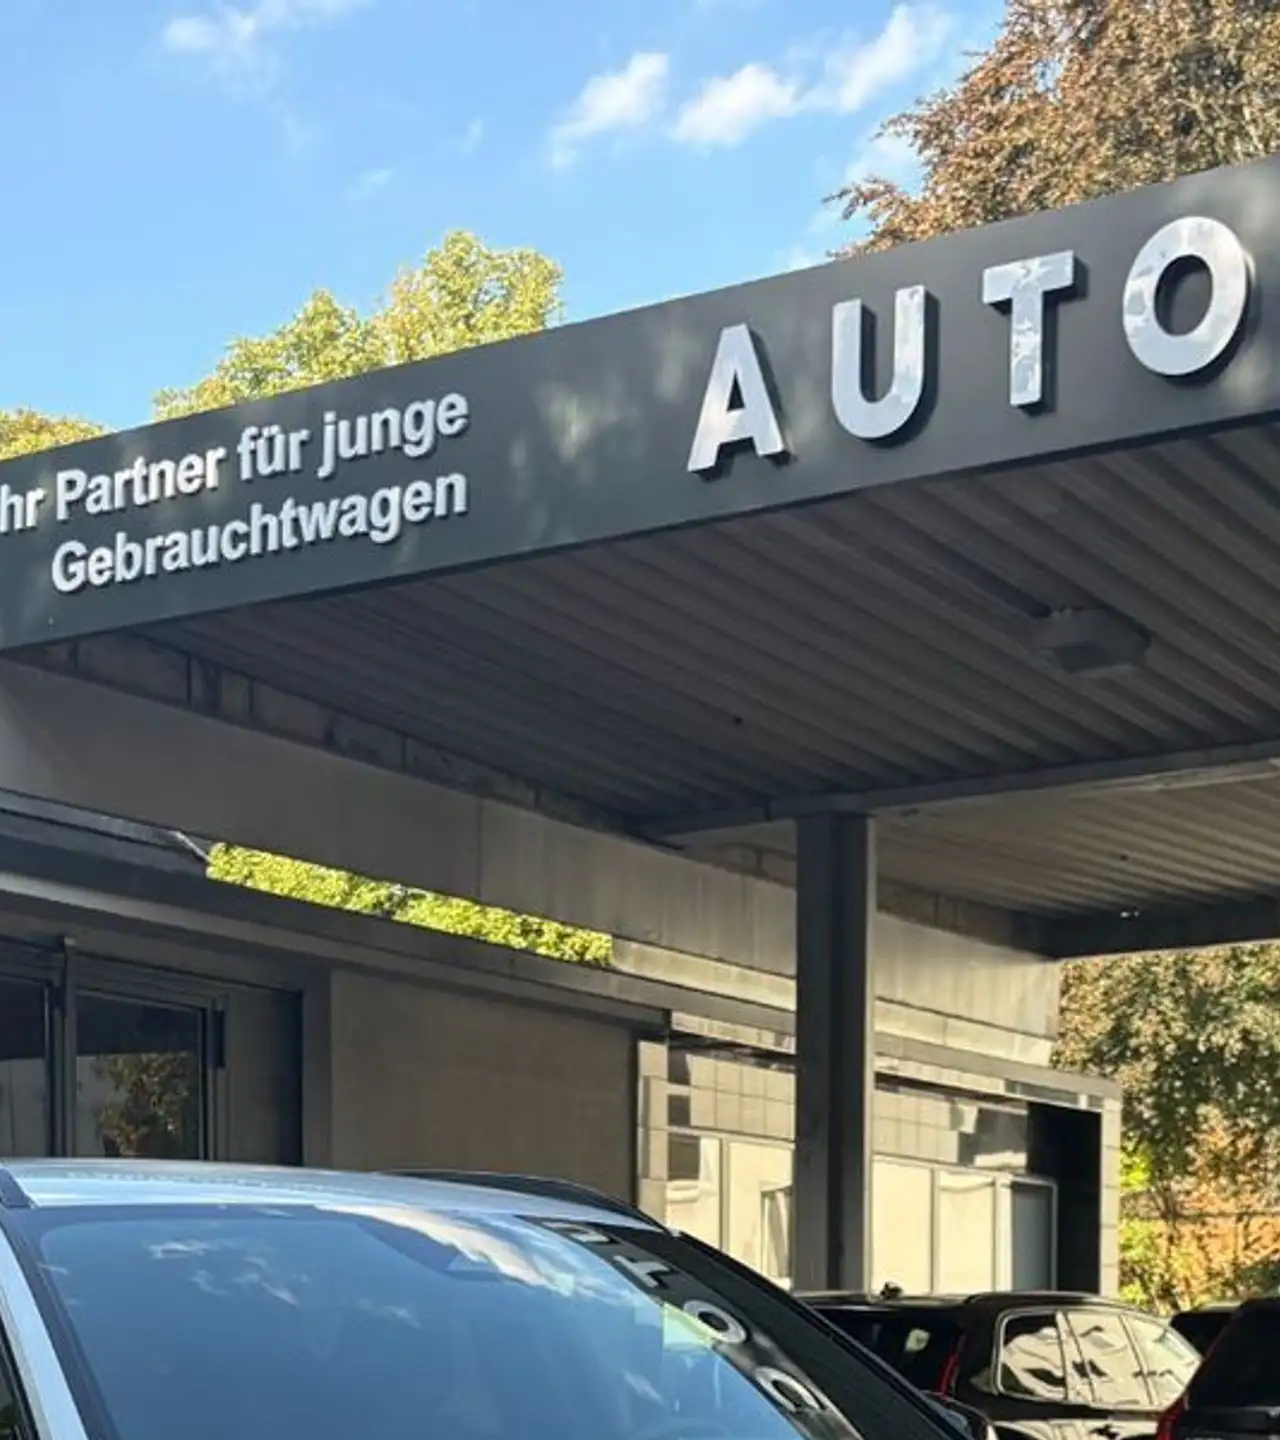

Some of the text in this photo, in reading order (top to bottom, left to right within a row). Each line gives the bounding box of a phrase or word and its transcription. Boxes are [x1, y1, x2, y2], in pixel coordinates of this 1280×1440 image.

[56, 445, 226, 521] Partner
[238, 425, 310, 481] für
[317, 393, 469, 479] junge
[52, 472, 468, 592] Gebrauchtwagen
